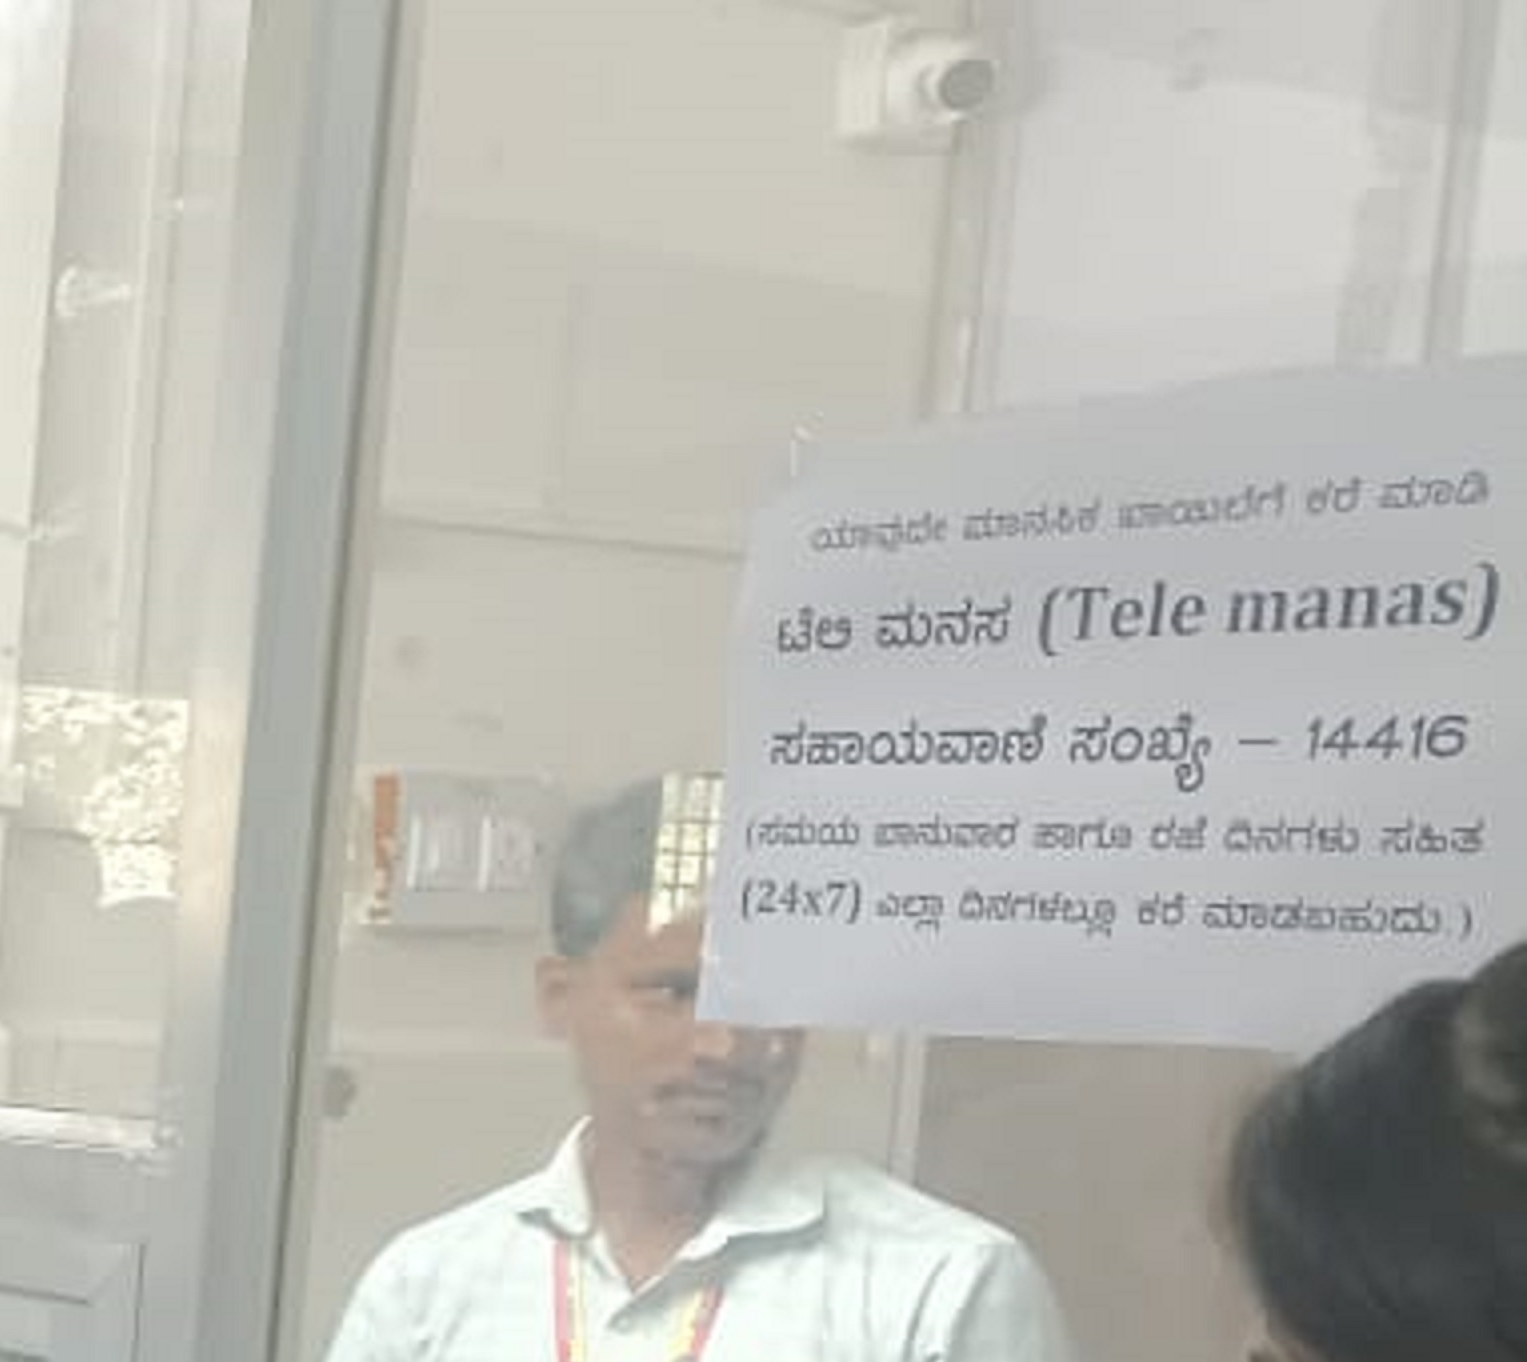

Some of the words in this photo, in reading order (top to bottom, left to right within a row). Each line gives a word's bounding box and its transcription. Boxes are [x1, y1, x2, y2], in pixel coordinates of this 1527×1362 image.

[1379, 469, 1489, 508] ಮಾಡಿ
[876, 597, 1012, 648] ಮನಸ
[1038, 580, 1207, 657] (Tele
[1225, 561, 1500, 641] manas)
[769, 713, 1048, 765] ಸಹಾಯವಾಣಿ
[1069, 713, 1212, 793] ಸಂಖ್ಯೆ
[1307, 714, 1469, 761] 14416
[741, 877, 863, 926] (24x7)
